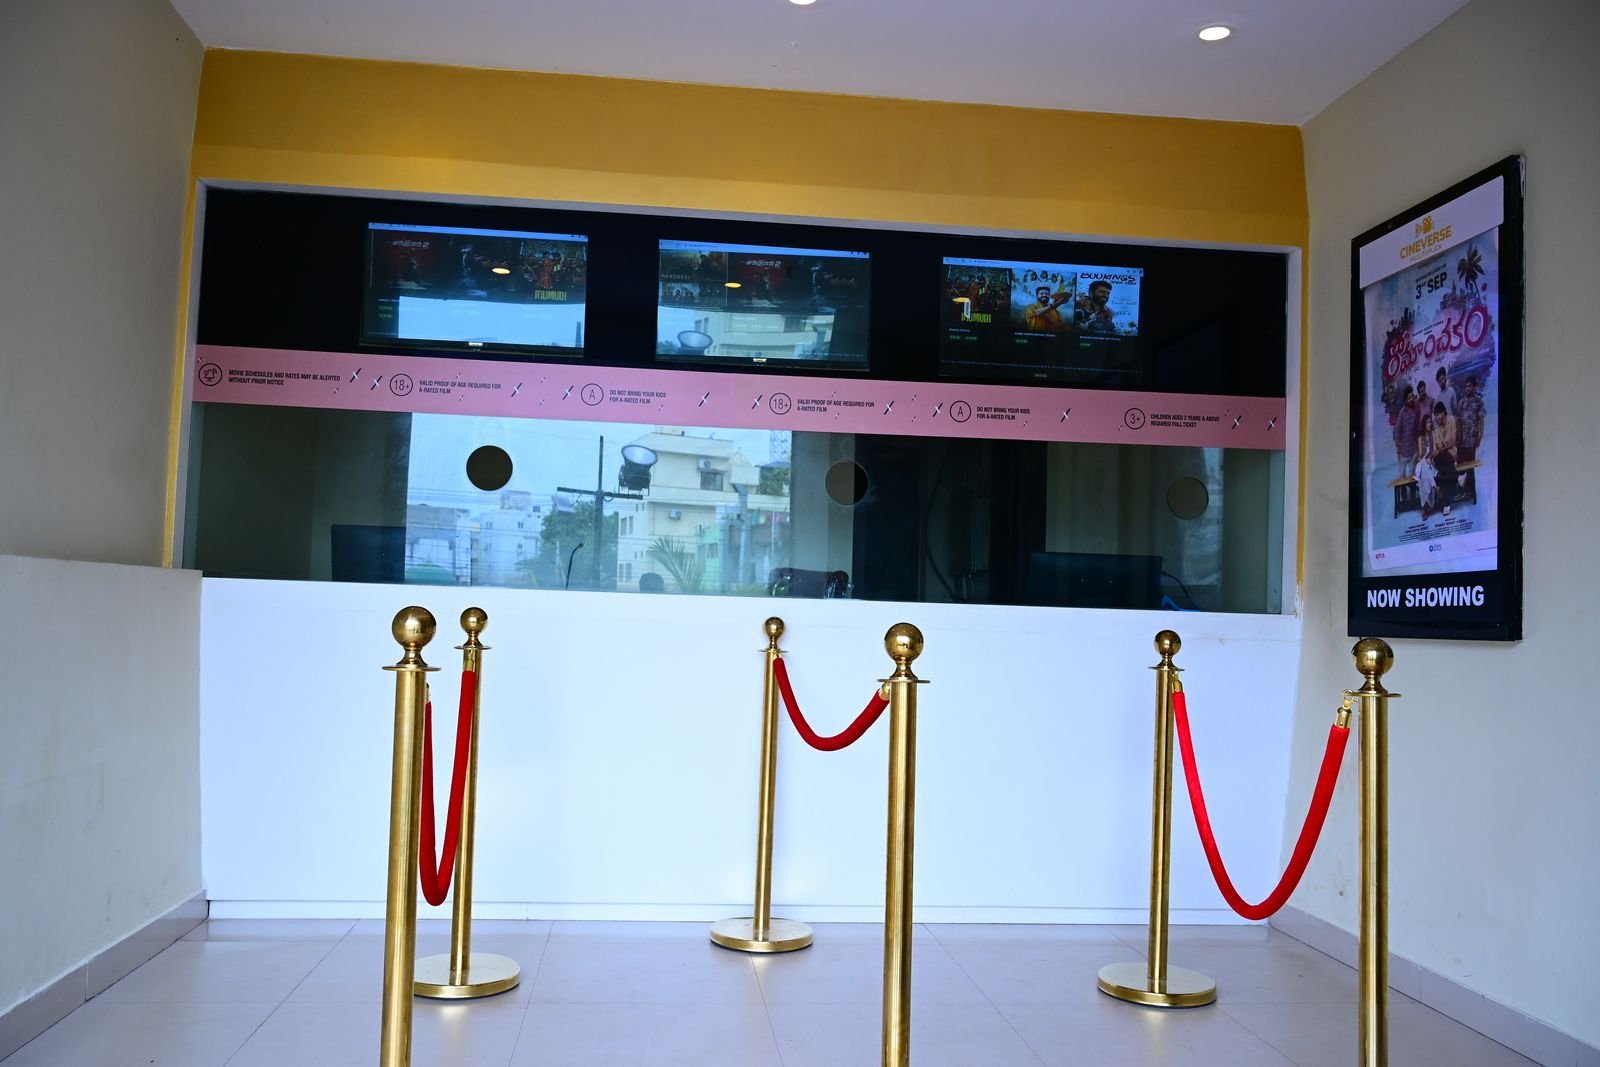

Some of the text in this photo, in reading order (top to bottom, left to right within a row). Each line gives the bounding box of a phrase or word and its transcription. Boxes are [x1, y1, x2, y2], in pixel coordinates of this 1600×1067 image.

[1400, 225, 1452, 259] CINEVERSE
[1427, 272, 1447, 294] SEP
[394, 379, 410, 391] 18+
[589, 389, 596, 400] A
[773, 398, 788, 410] 18+
[958, 406, 964, 417] A
[1130, 414, 1140, 424] 3+
[1367, 585, 1484, 608] NOW SHOWING
